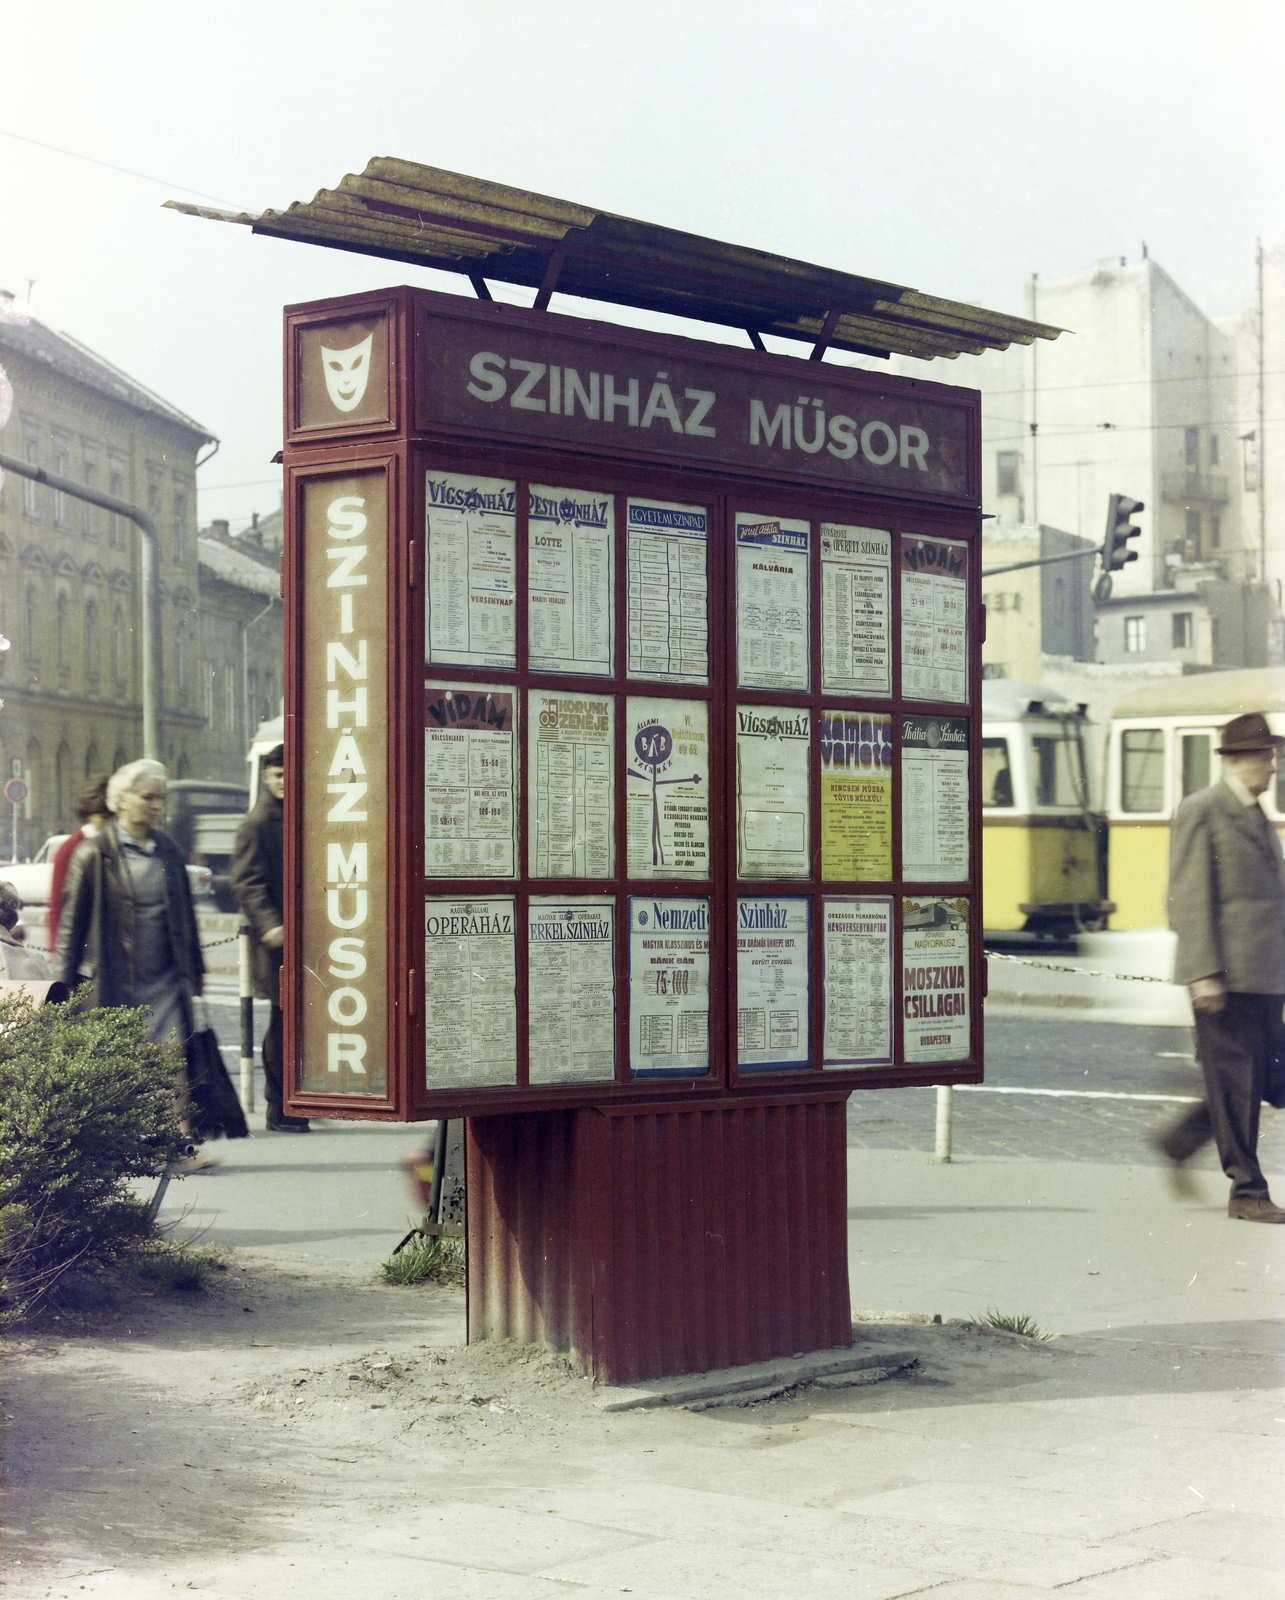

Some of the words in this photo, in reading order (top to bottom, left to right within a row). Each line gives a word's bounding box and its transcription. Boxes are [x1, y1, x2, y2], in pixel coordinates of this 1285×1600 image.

[466, 351, 717, 439] SZINHÁZ
[749, 396, 930, 472] MŰSOR
[631, 508, 672, 525] EGYETEMI
[535, 536, 562, 547] LOTTE
[771, 532, 806, 547] SZÍNHÁZ
[861, 540, 888, 556] SZÍNHÁZ
[753, 563, 794, 574] KÁLVÁRIA
[470, 596, 514, 606] VERSENYNAP
[326, 496, 368, 822] SZINHÁZ
[559, 699, 609, 715] KORUNK
[641, 733, 666, 757] BÁB
[830, 784, 860, 792] NINCSEN
[862, 784, 885, 793] MÚZSA
[427, 913, 511, 935] OPERAHÁZ
[652, 902, 706, 930] Nemzeti
[529, 923, 566, 940] ERKEL
[566, 919, 609, 940] SZÍNHÁZ
[904, 965, 965, 991] MOSZKVA
[904, 993, 965, 1019] CSILLAGAI
